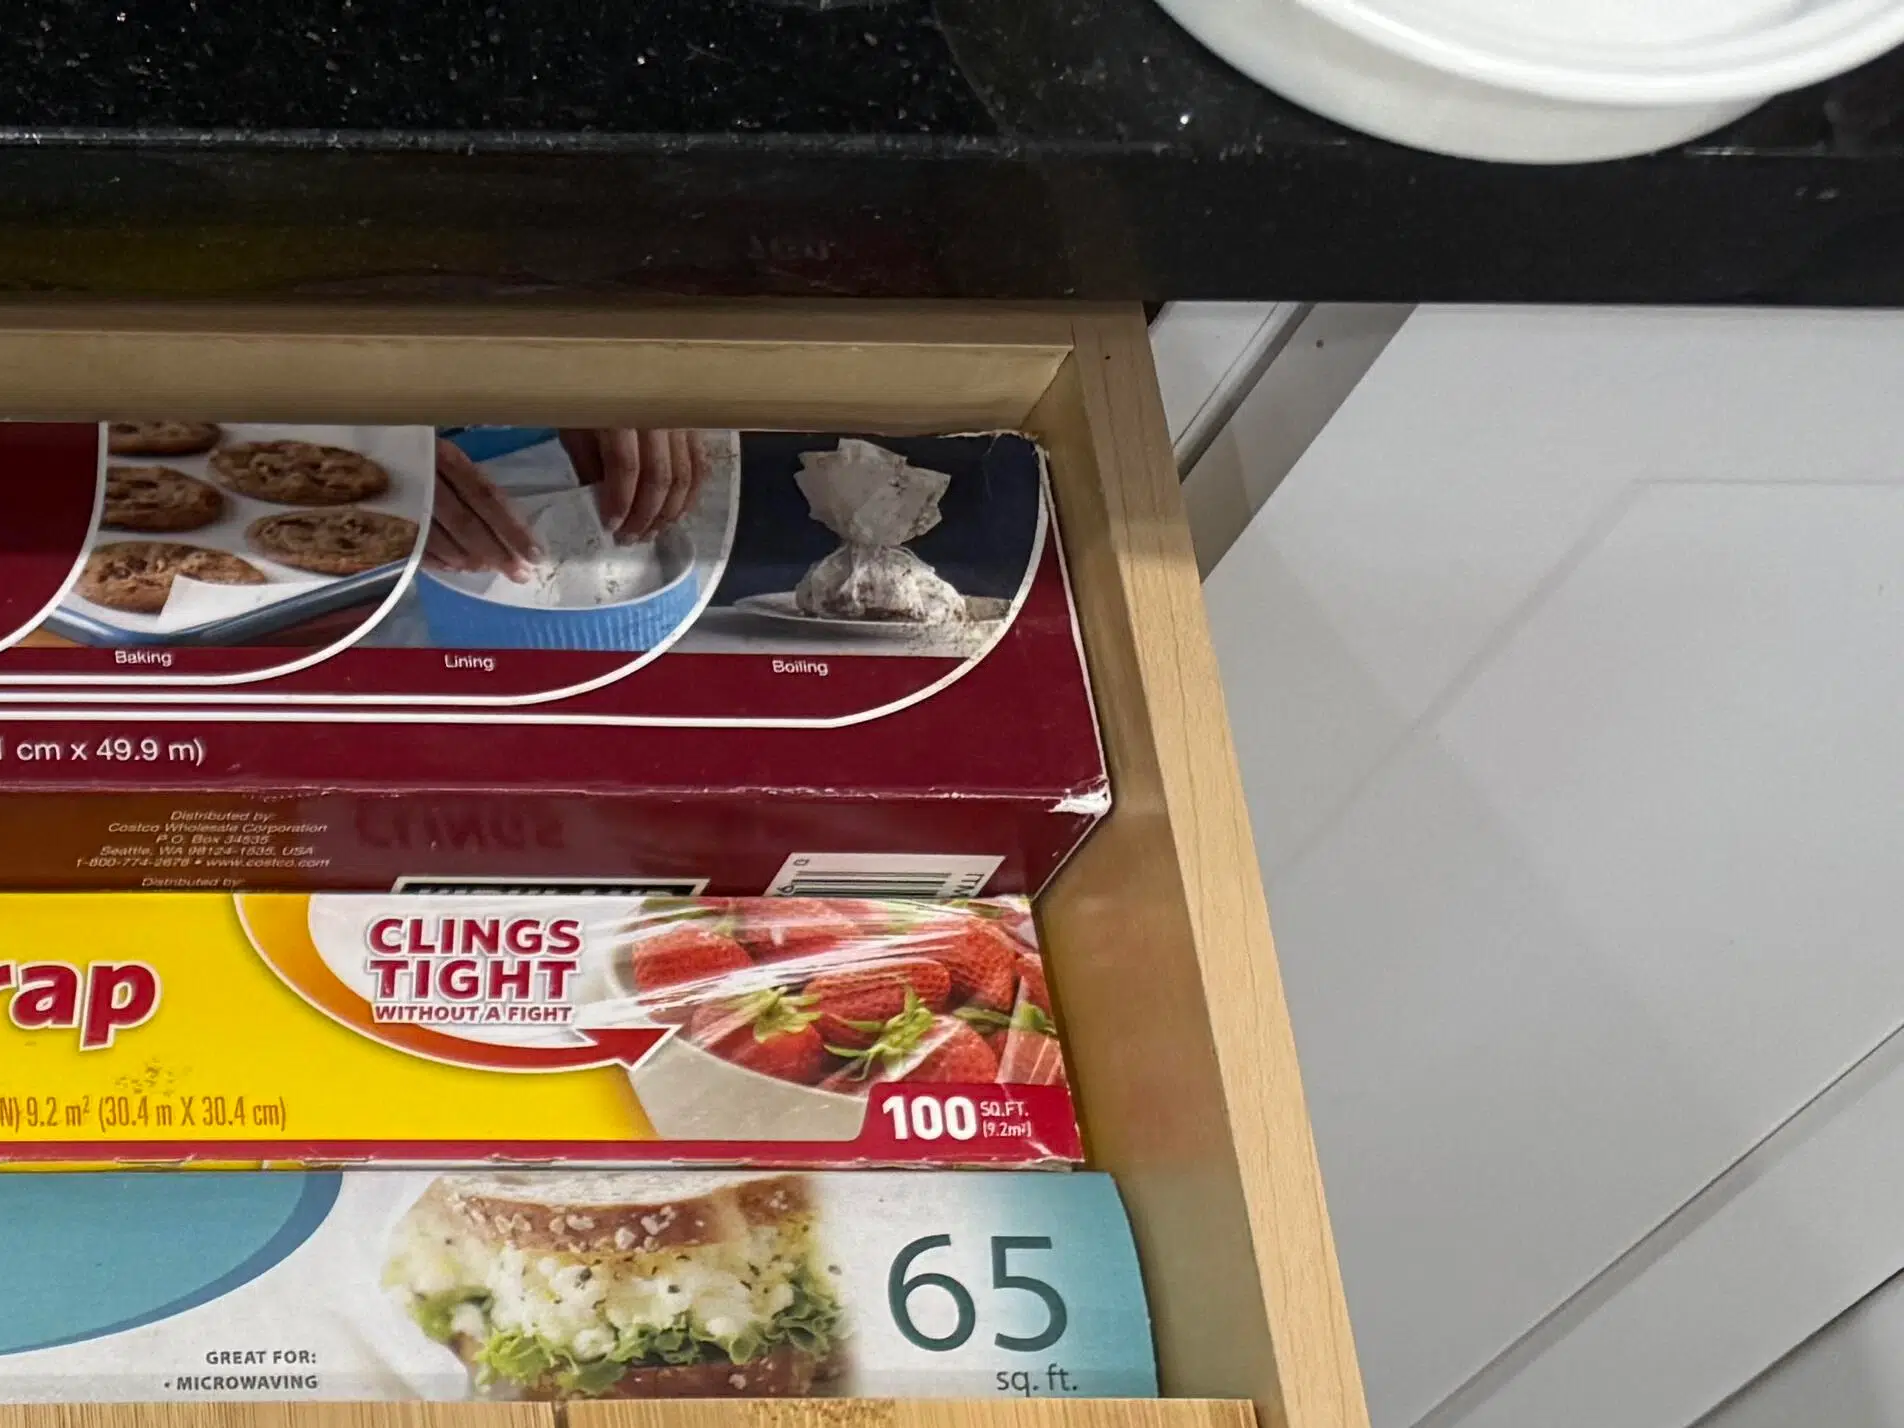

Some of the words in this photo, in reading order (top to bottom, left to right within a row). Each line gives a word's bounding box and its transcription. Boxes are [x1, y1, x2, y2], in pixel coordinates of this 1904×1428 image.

[113, 649, 173, 669] Baking
[444, 653, 496, 673] Lining
[771, 658, 830, 677] Boiling
[16, 743, 63, 763] cm
[70, 743, 90, 762] x
[96, 739, 161, 764] 49.9
[167, 737, 208, 767] m)
[108, 822, 160, 834] Costco
[162, 822, 239, 834] Wholesale
[242, 822, 329, 835] Corporation
[367, 917, 582, 956] CLINGS
[368, 958, 578, 1001] TIGHT
[375, 1004, 478, 1022] WITHOUT
[483, 1004, 502, 1021] A
[507, 1004, 573, 1022] FIGHT
[26, 1097, 60, 1128] 9.2
[98, 1095, 149, 1133] (30.4
[156, 1102, 173, 1127] m
[180, 1096, 197, 1127] X
[202, 1096, 246, 1127] 30.4
[252, 1095, 288, 1133] cm)
[882, 1095, 978, 1141] 100
[980, 1101, 1030, 1117] SQ.FT.
[887, 1233, 1068, 1353] 65
[206, 1350, 269, 1367] GREAT
[274, 1349, 318, 1366] FOR:
[176, 1374, 319, 1392] MICROWAVING
[996, 1369, 1041, 1398] sq.
[1046, 1362, 1079, 1392] ft.
